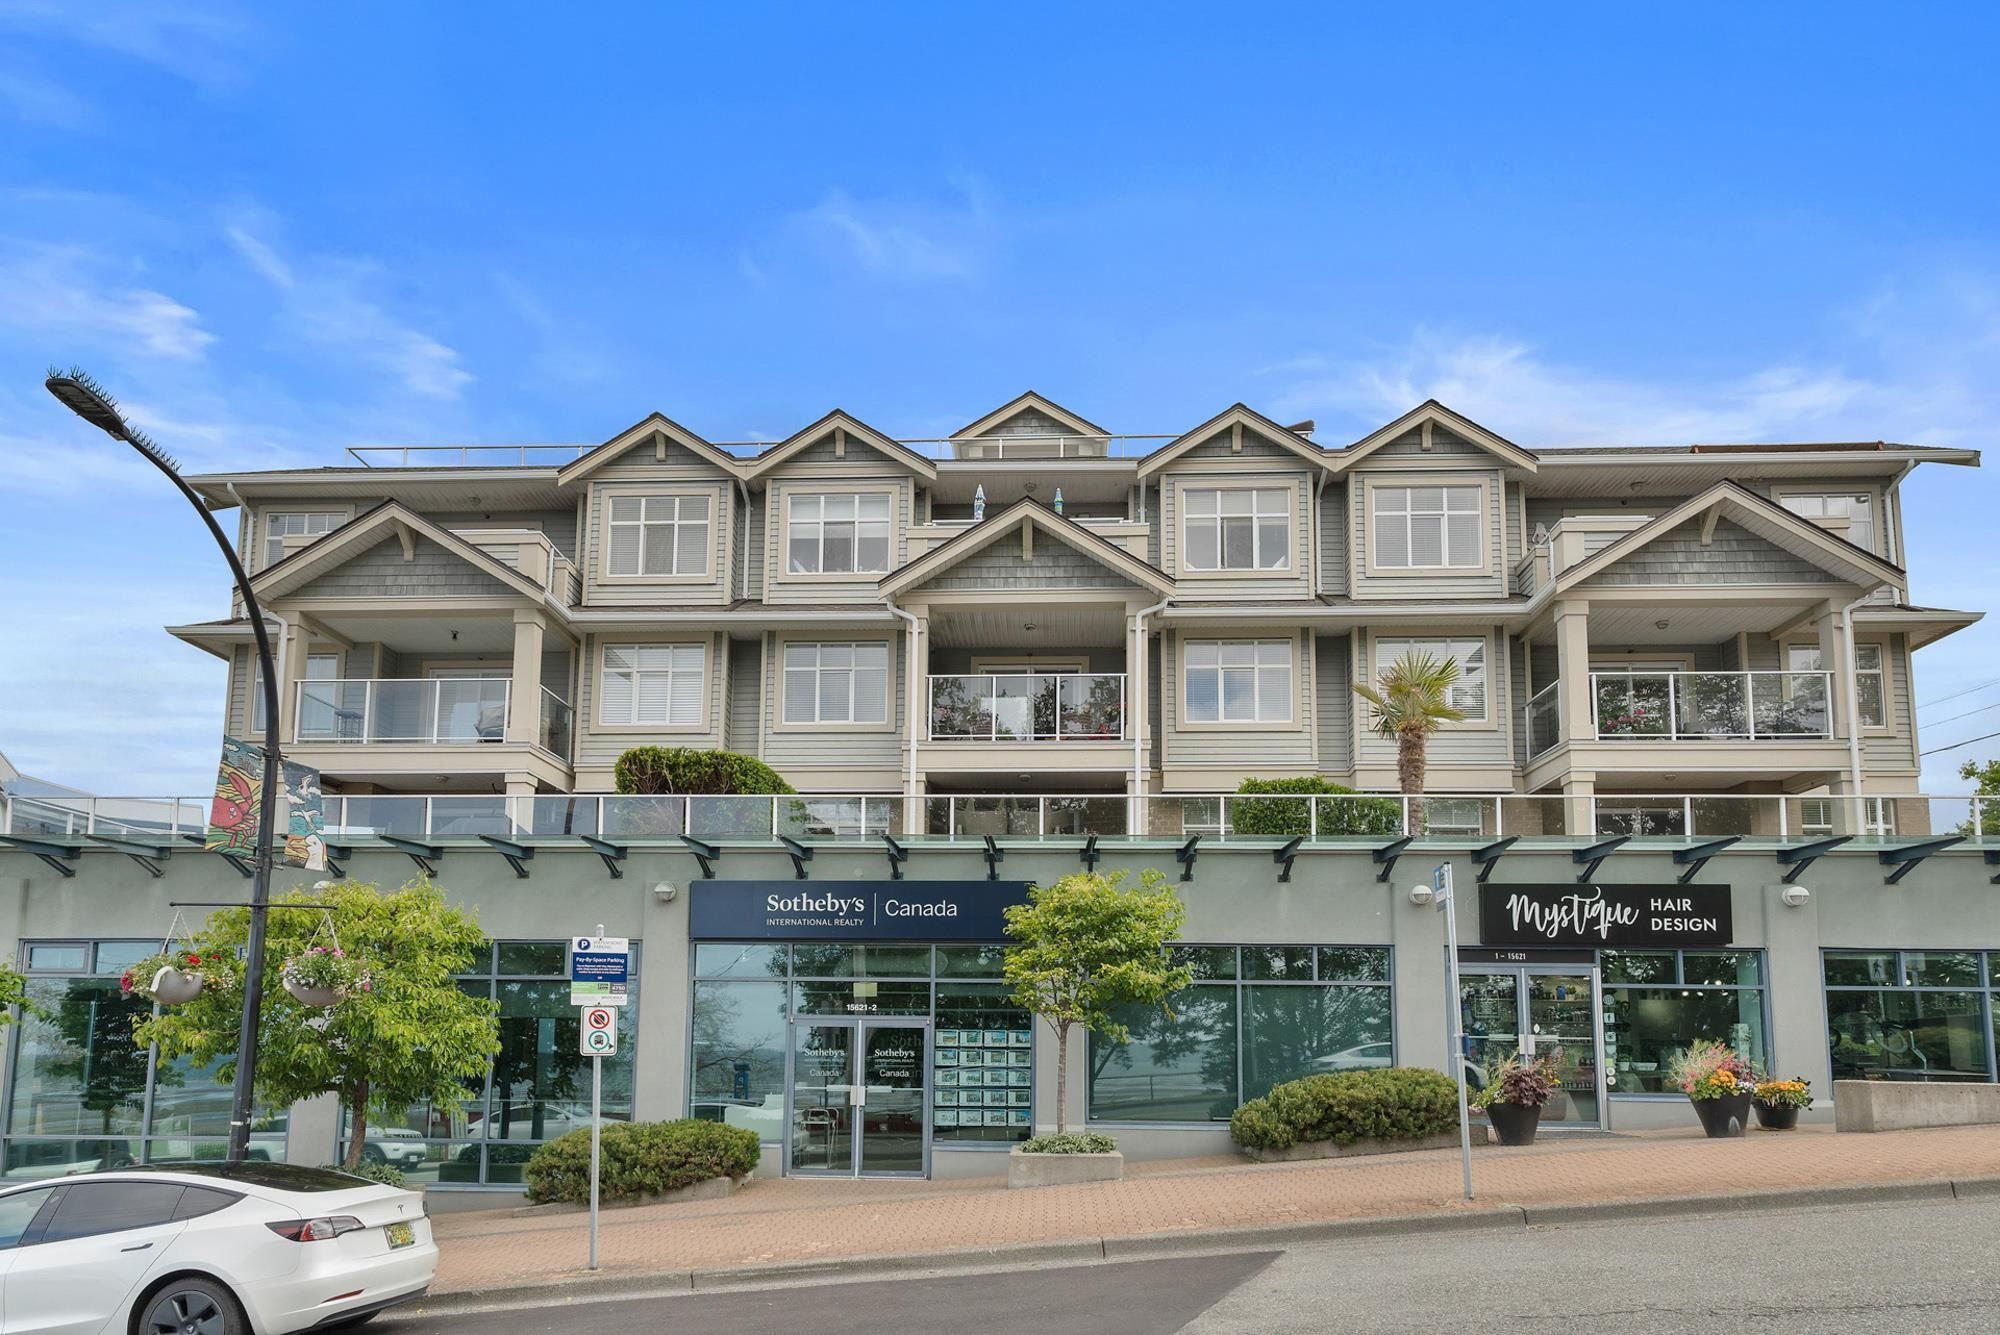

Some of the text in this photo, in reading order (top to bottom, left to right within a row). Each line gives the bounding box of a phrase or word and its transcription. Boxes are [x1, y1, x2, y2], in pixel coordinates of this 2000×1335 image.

[766, 892, 865, 916] Sotheby's
[885, 899, 958, 917] Canada
[1650, 897, 1693, 912] HAIR
[766, 918, 865, 926] INTERNATIONAL REALTY
[1651, 917, 1717, 932] DESIGN
[1507, 952, 1526, 960] 15621
[846, 1003, 877, 1011] 15621-2
[804, 1048, 845, 1058] Sotheby's
[874, 1048, 915, 1058] Sotheby's
[809, 1068, 840, 1077] Canada
[879, 1069, 910, 1077] Canada
